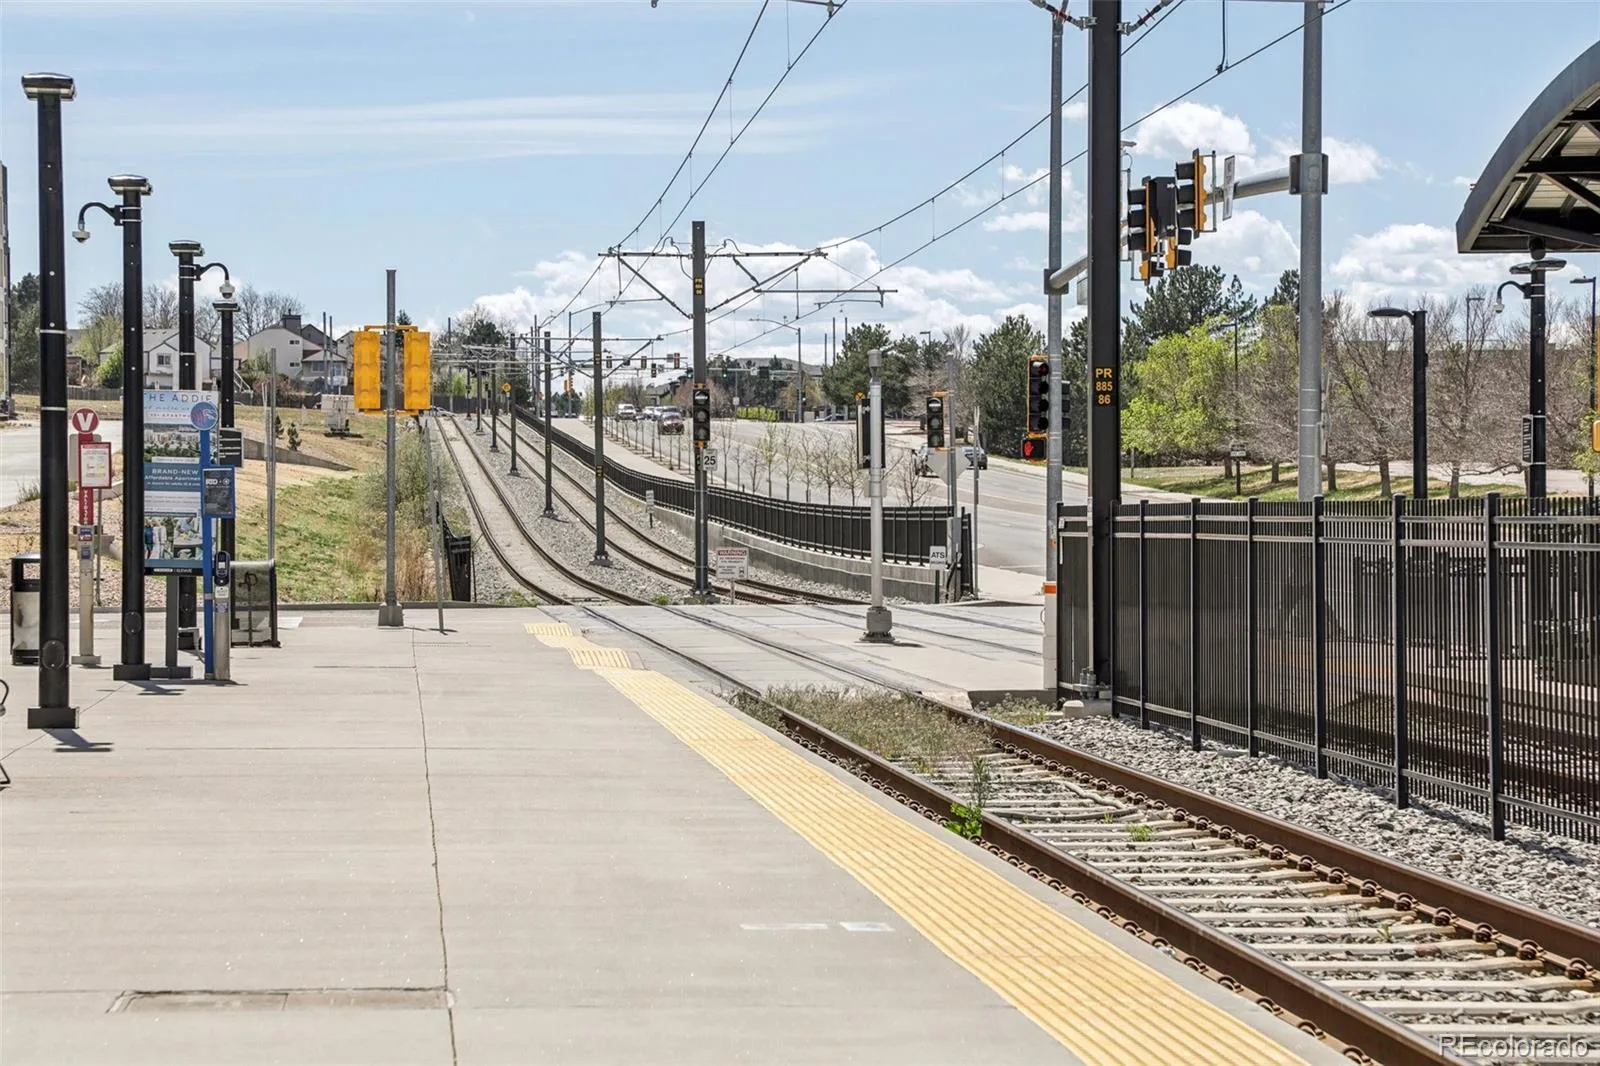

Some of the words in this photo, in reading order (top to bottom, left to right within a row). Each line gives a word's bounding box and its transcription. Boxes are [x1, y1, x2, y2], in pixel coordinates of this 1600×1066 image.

[1095, 368, 1113, 378] PR
[1095, 381, 1113, 392] 885
[1098, 394, 1111, 405] 86
[76, 412, 94, 431] V
[703, 455, 716, 466] 25
[931, 551, 945, 559] ATS
